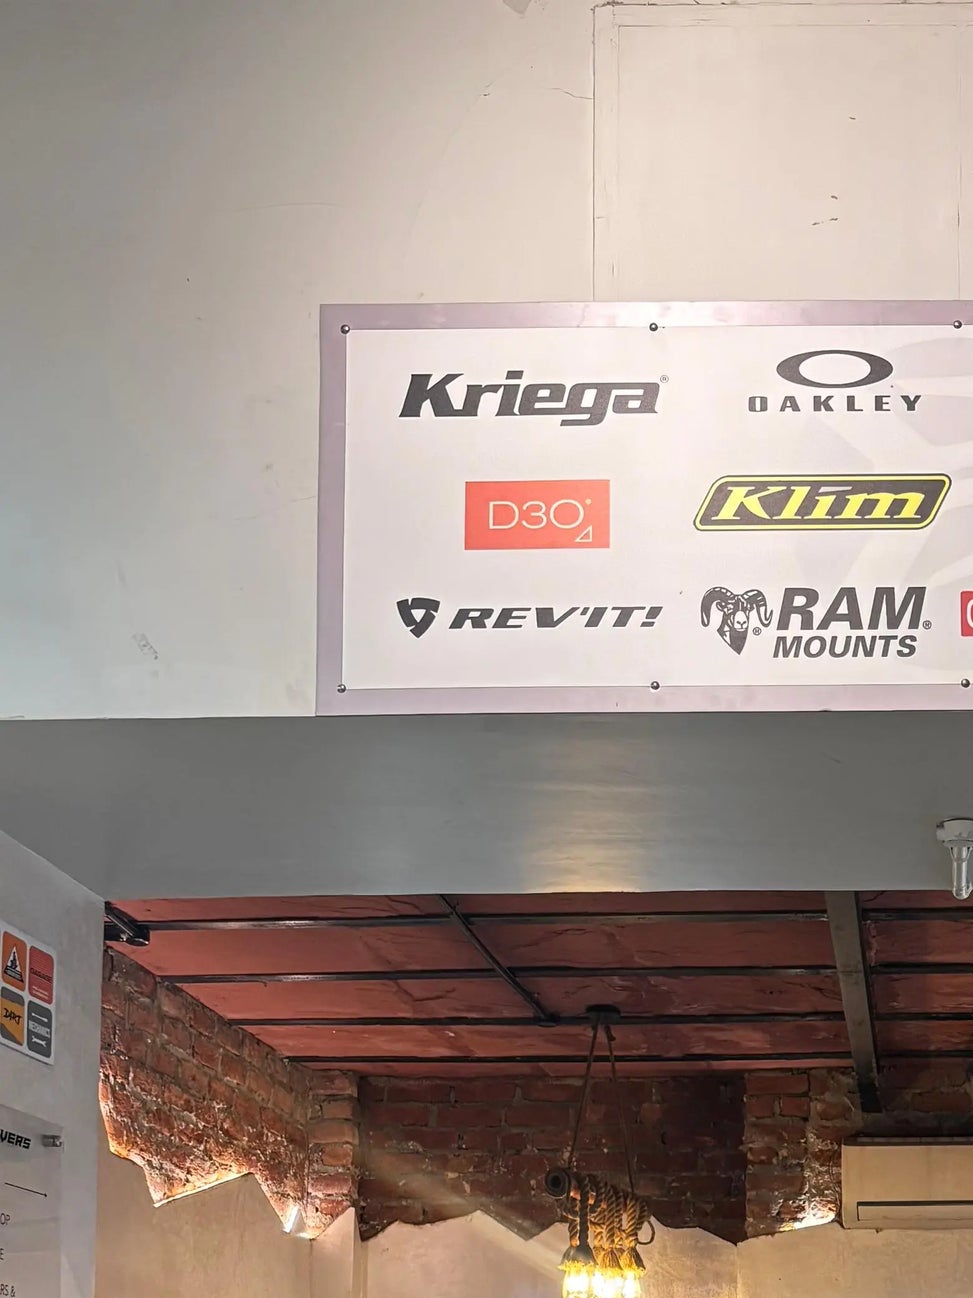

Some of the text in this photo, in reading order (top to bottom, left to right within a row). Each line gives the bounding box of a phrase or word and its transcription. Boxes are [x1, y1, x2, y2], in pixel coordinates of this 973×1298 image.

[398, 370, 660, 427] Kriega
[748, 394, 923, 413] OAKLEY
[710, 483, 926, 521] Klim
[449, 606, 664, 629] REV'IT!
[778, 586, 927, 631] RAM
[772, 635, 918, 659] MOUNTS
